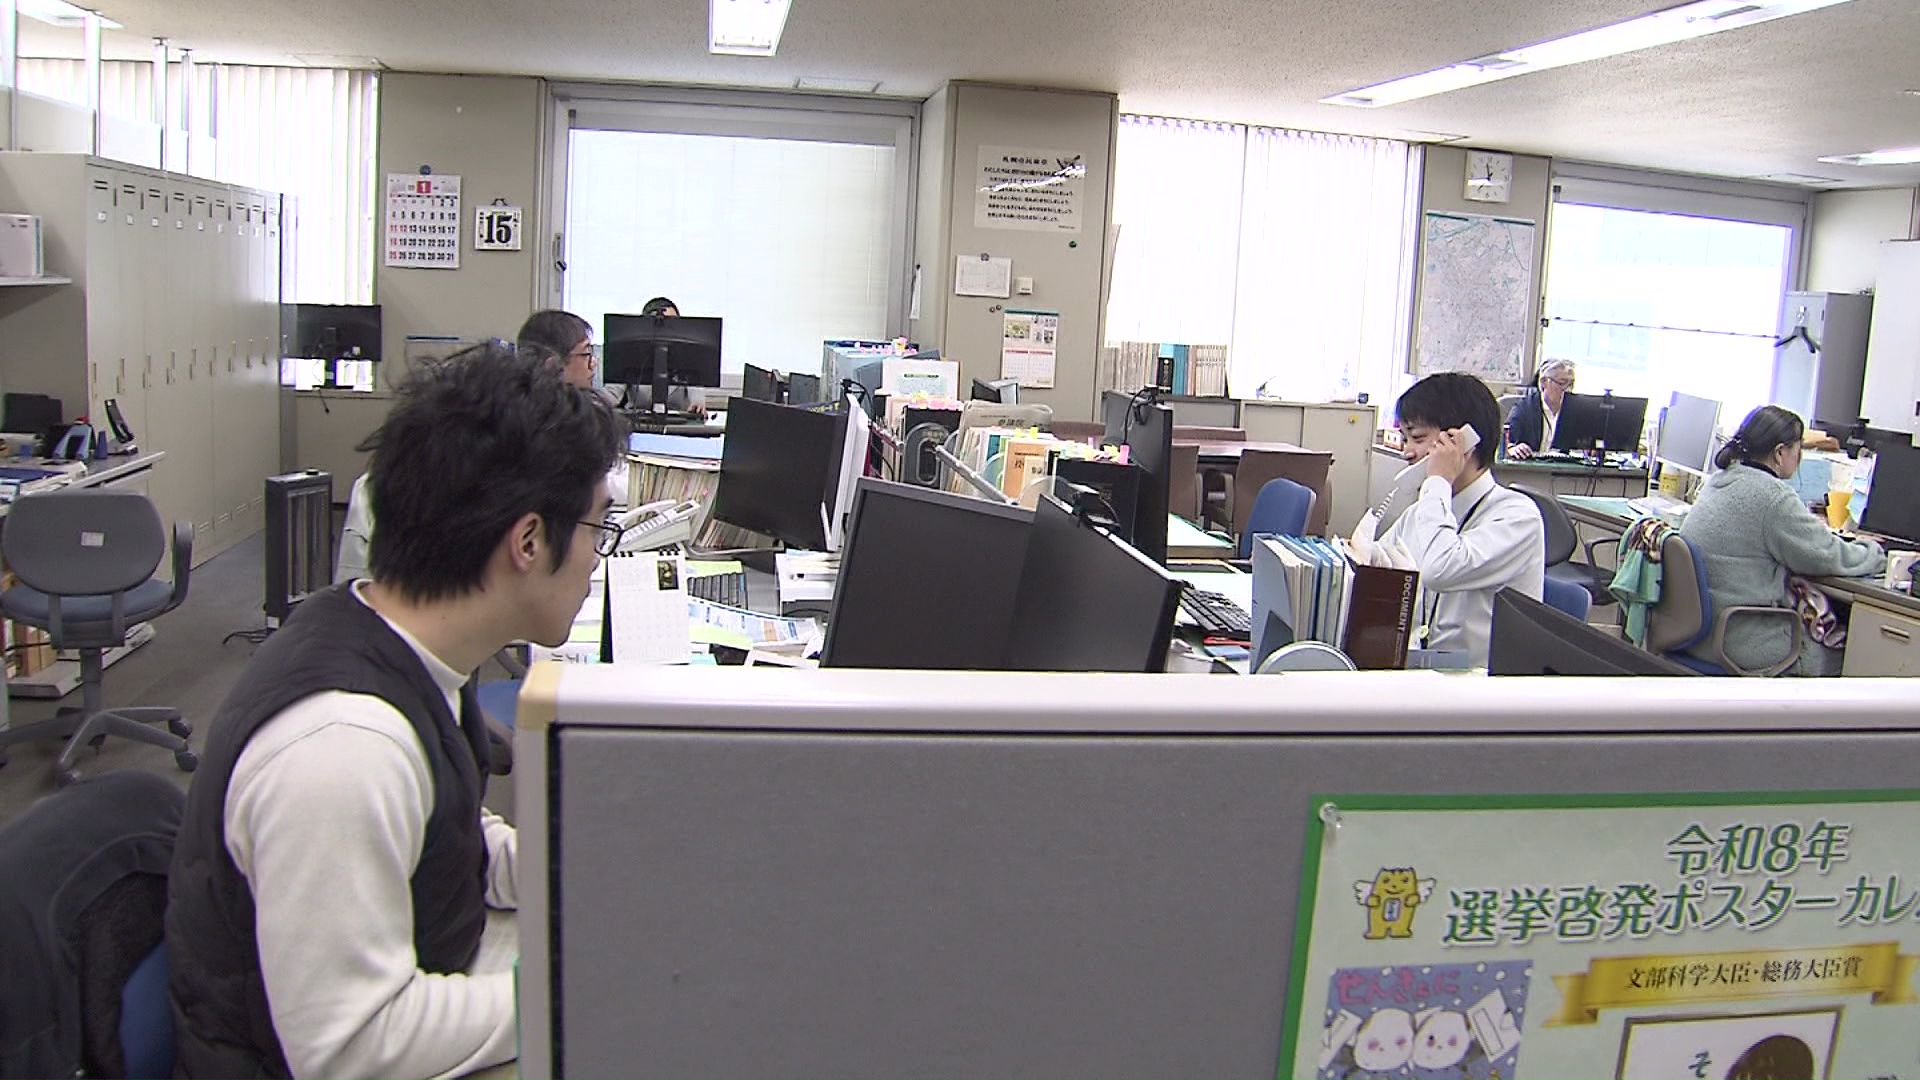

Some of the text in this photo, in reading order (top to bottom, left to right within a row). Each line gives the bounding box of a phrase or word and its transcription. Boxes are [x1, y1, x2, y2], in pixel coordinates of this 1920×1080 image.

[409, 225, 417, 233] 13
[419, 225, 427, 233] 14
[428, 225, 437, 233] 15
[448, 226, 456, 234] 17
[485, 214, 513, 243] 15
[1397, 575, 1412, 632] DOCUMENT
[1667, 821, 1849, 875] 令和8年
[1443, 875, 1920, 943] 選挙啓発ポスターカレ
